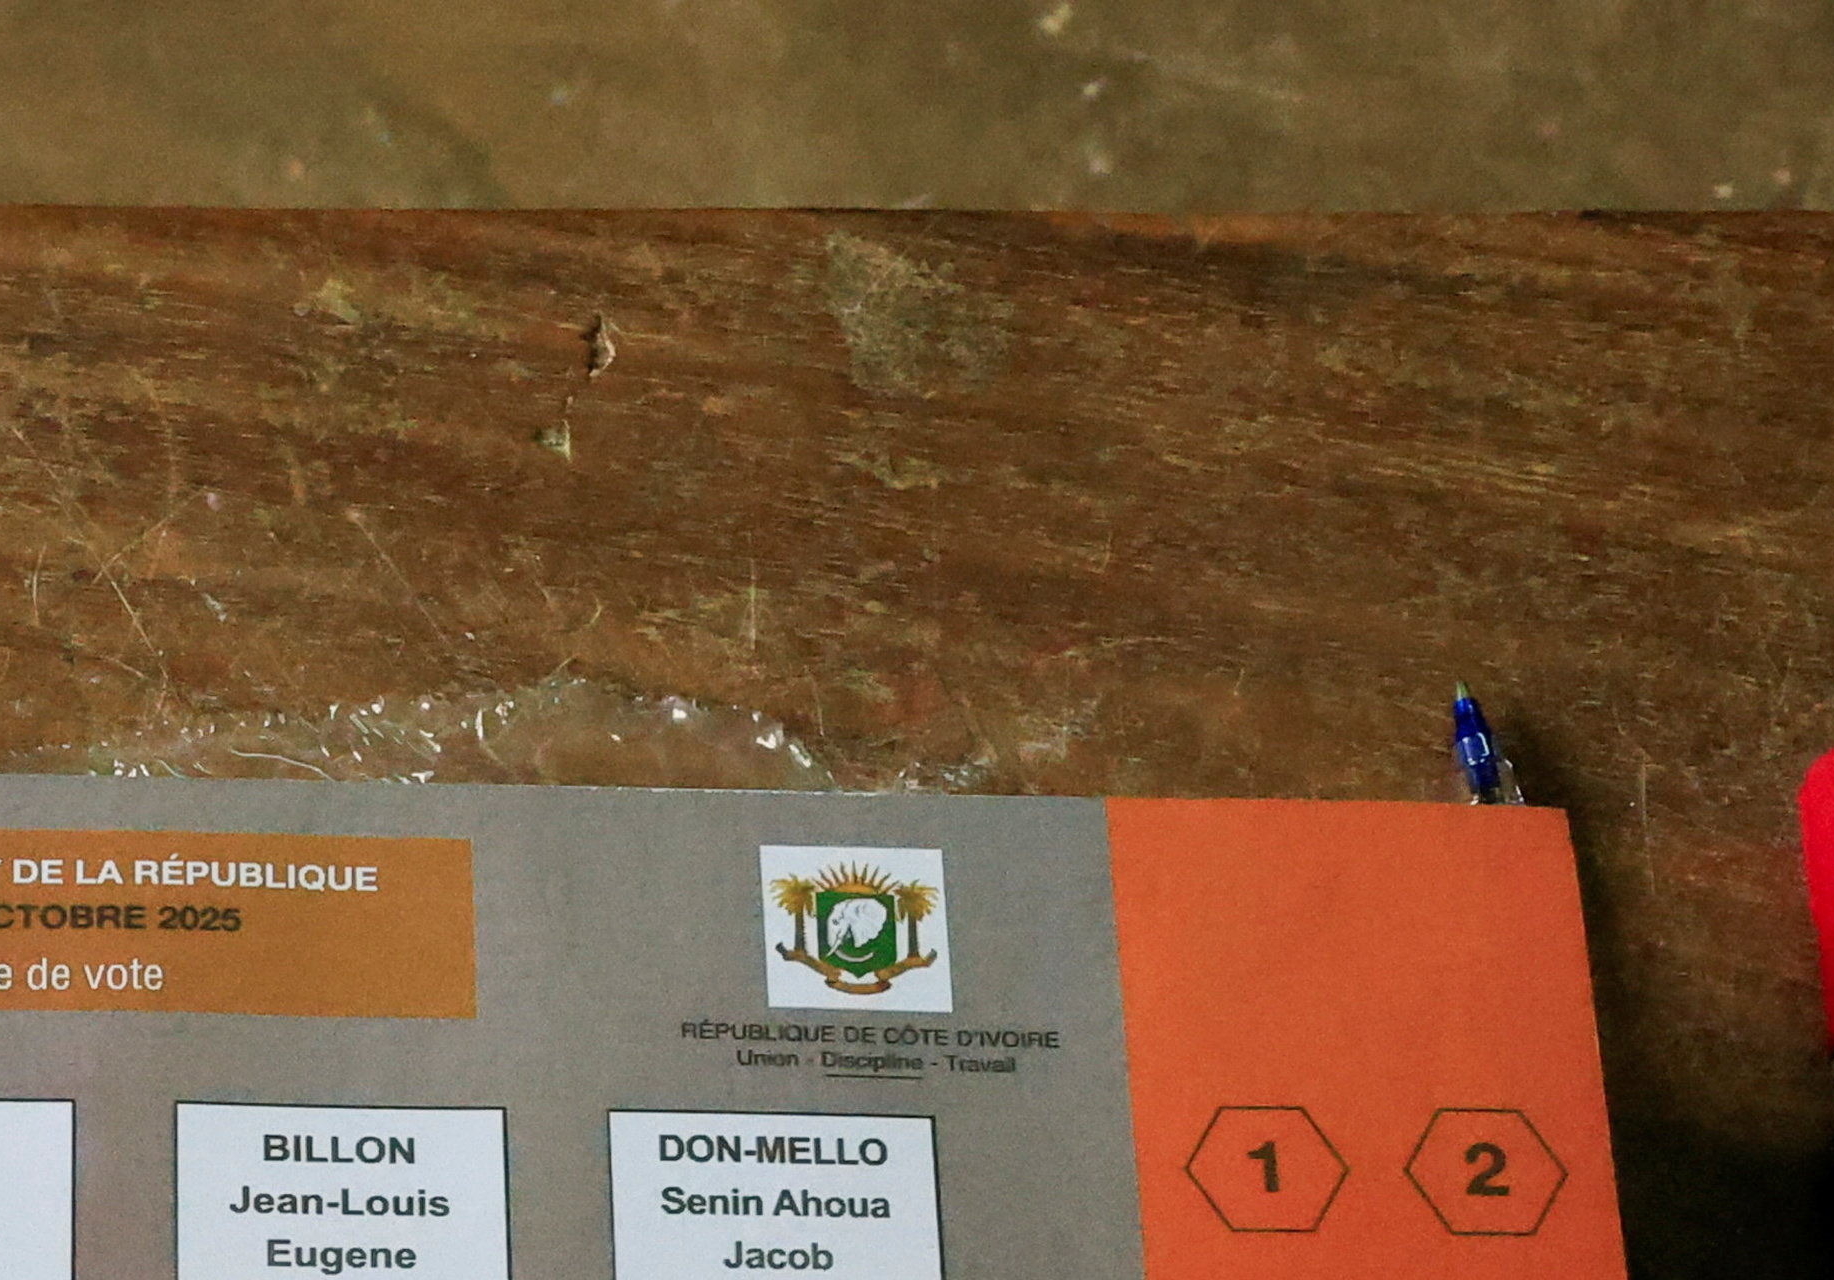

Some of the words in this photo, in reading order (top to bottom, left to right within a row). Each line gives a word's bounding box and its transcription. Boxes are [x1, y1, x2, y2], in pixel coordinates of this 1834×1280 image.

[12, 858, 63, 884] DE
[75, 859, 123, 885] LA
[134, 853, 378, 893] RÉPUBLIQUE
[157, 905, 242, 932] 2025
[27, 957, 70, 991] de
[83, 961, 164, 992] vote
[681, 1020, 835, 1043] RÉPUBLIQUE
[844, 1025, 876, 1044] DE
[883, 1021, 949, 1046] CÔTE
[956, 1029, 1060, 1049] D'IVOIRE
[736, 1049, 799, 1067] Union
[821, 1051, 923, 1071] Discipline
[946, 1055, 1017, 1073] Travail
[262, 1133, 416, 1164] BILLON
[658, 1133, 889, 1167] DON-MELLO
[1246, 1140, 1280, 1193] 1
[1464, 1142, 1510, 1197] 2
[229, 1185, 451, 1217] Jean-Louis
[660, 1186, 763, 1216] Senin
[772, 1188, 891, 1219] Ahoua
[266, 1238, 417, 1275] Eugene
[723, 1240, 835, 1271] Jacob
